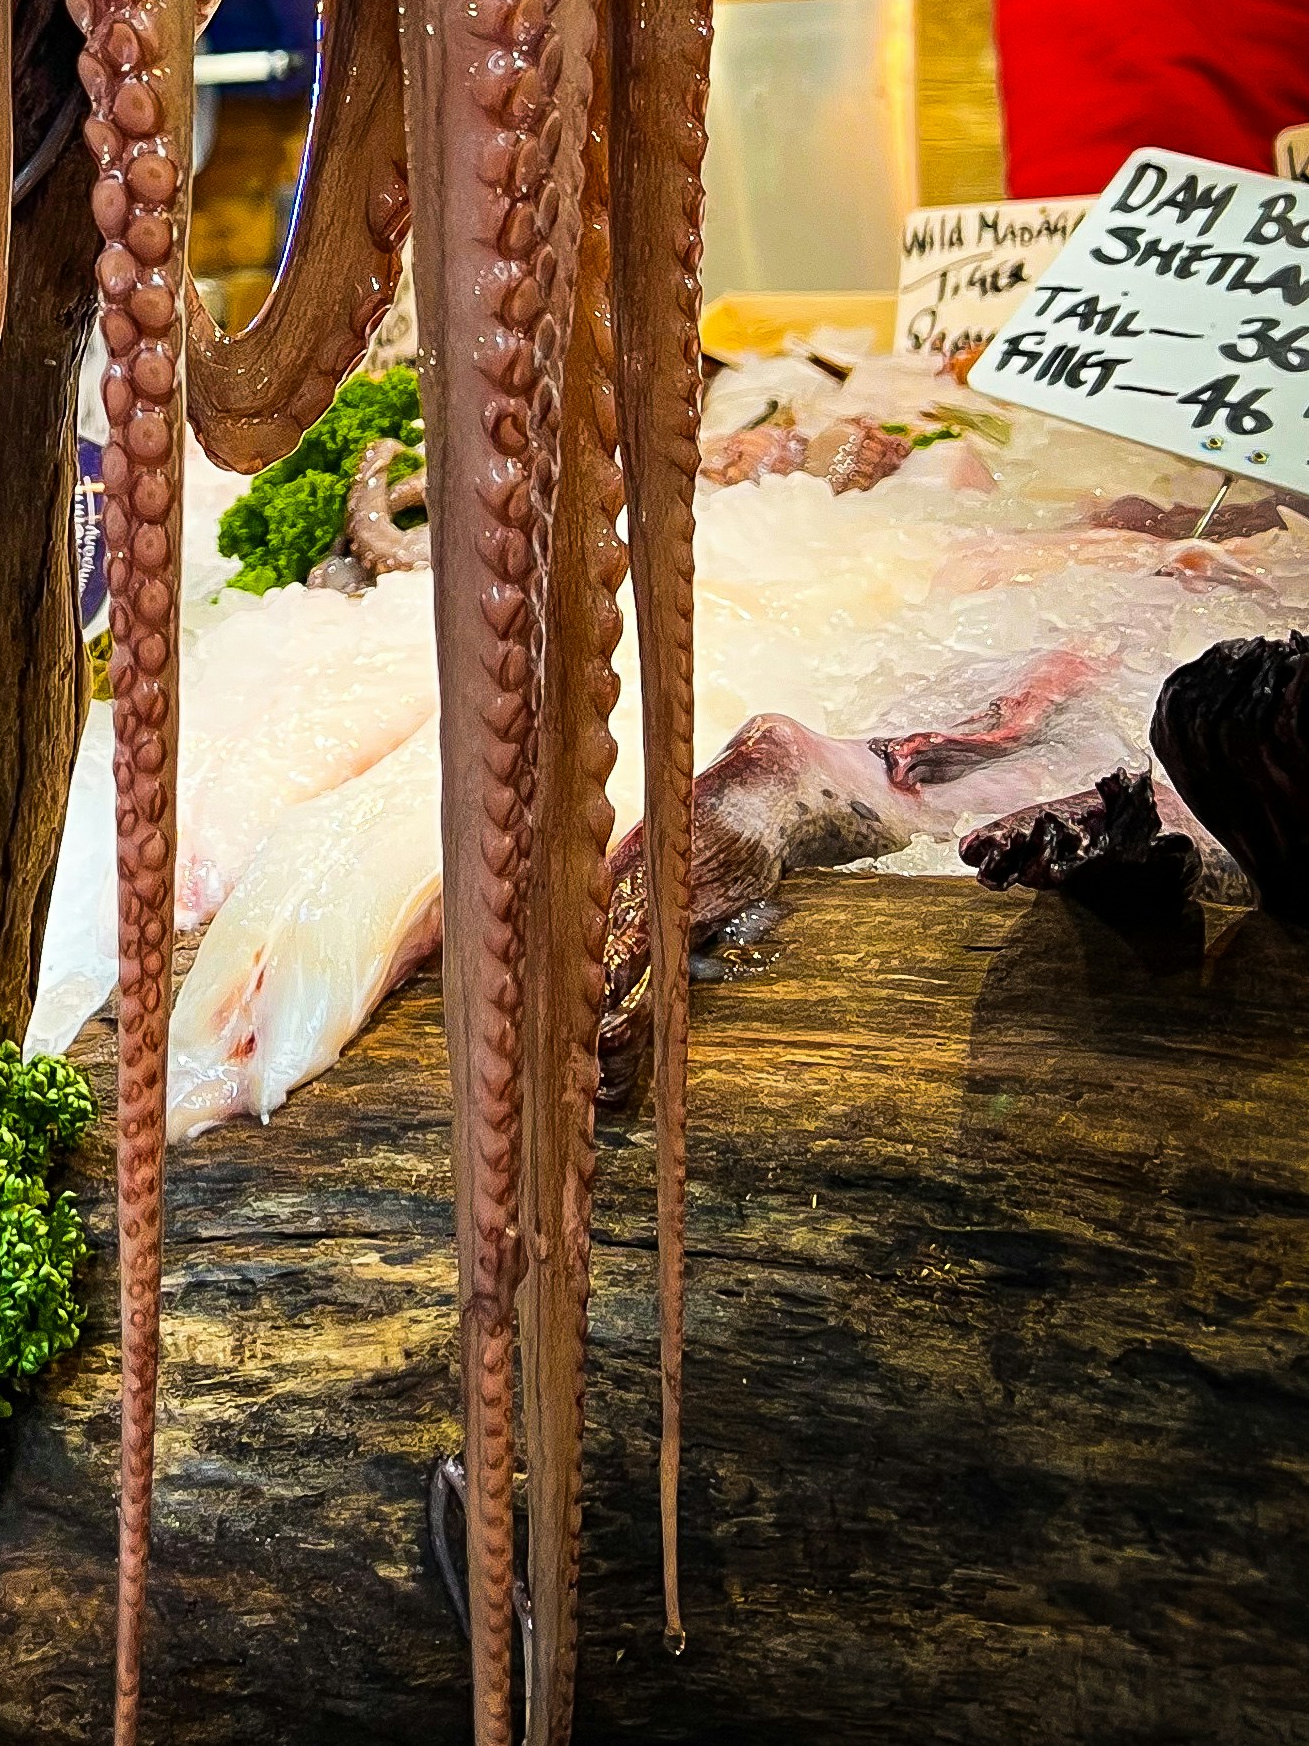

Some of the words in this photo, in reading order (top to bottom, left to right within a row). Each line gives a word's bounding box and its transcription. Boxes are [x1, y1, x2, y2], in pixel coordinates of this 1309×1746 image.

[1110, 161, 1238, 236] DAY
[1217, 316, 1309, 373] 36
[1176, 373, 1274, 436] 46
